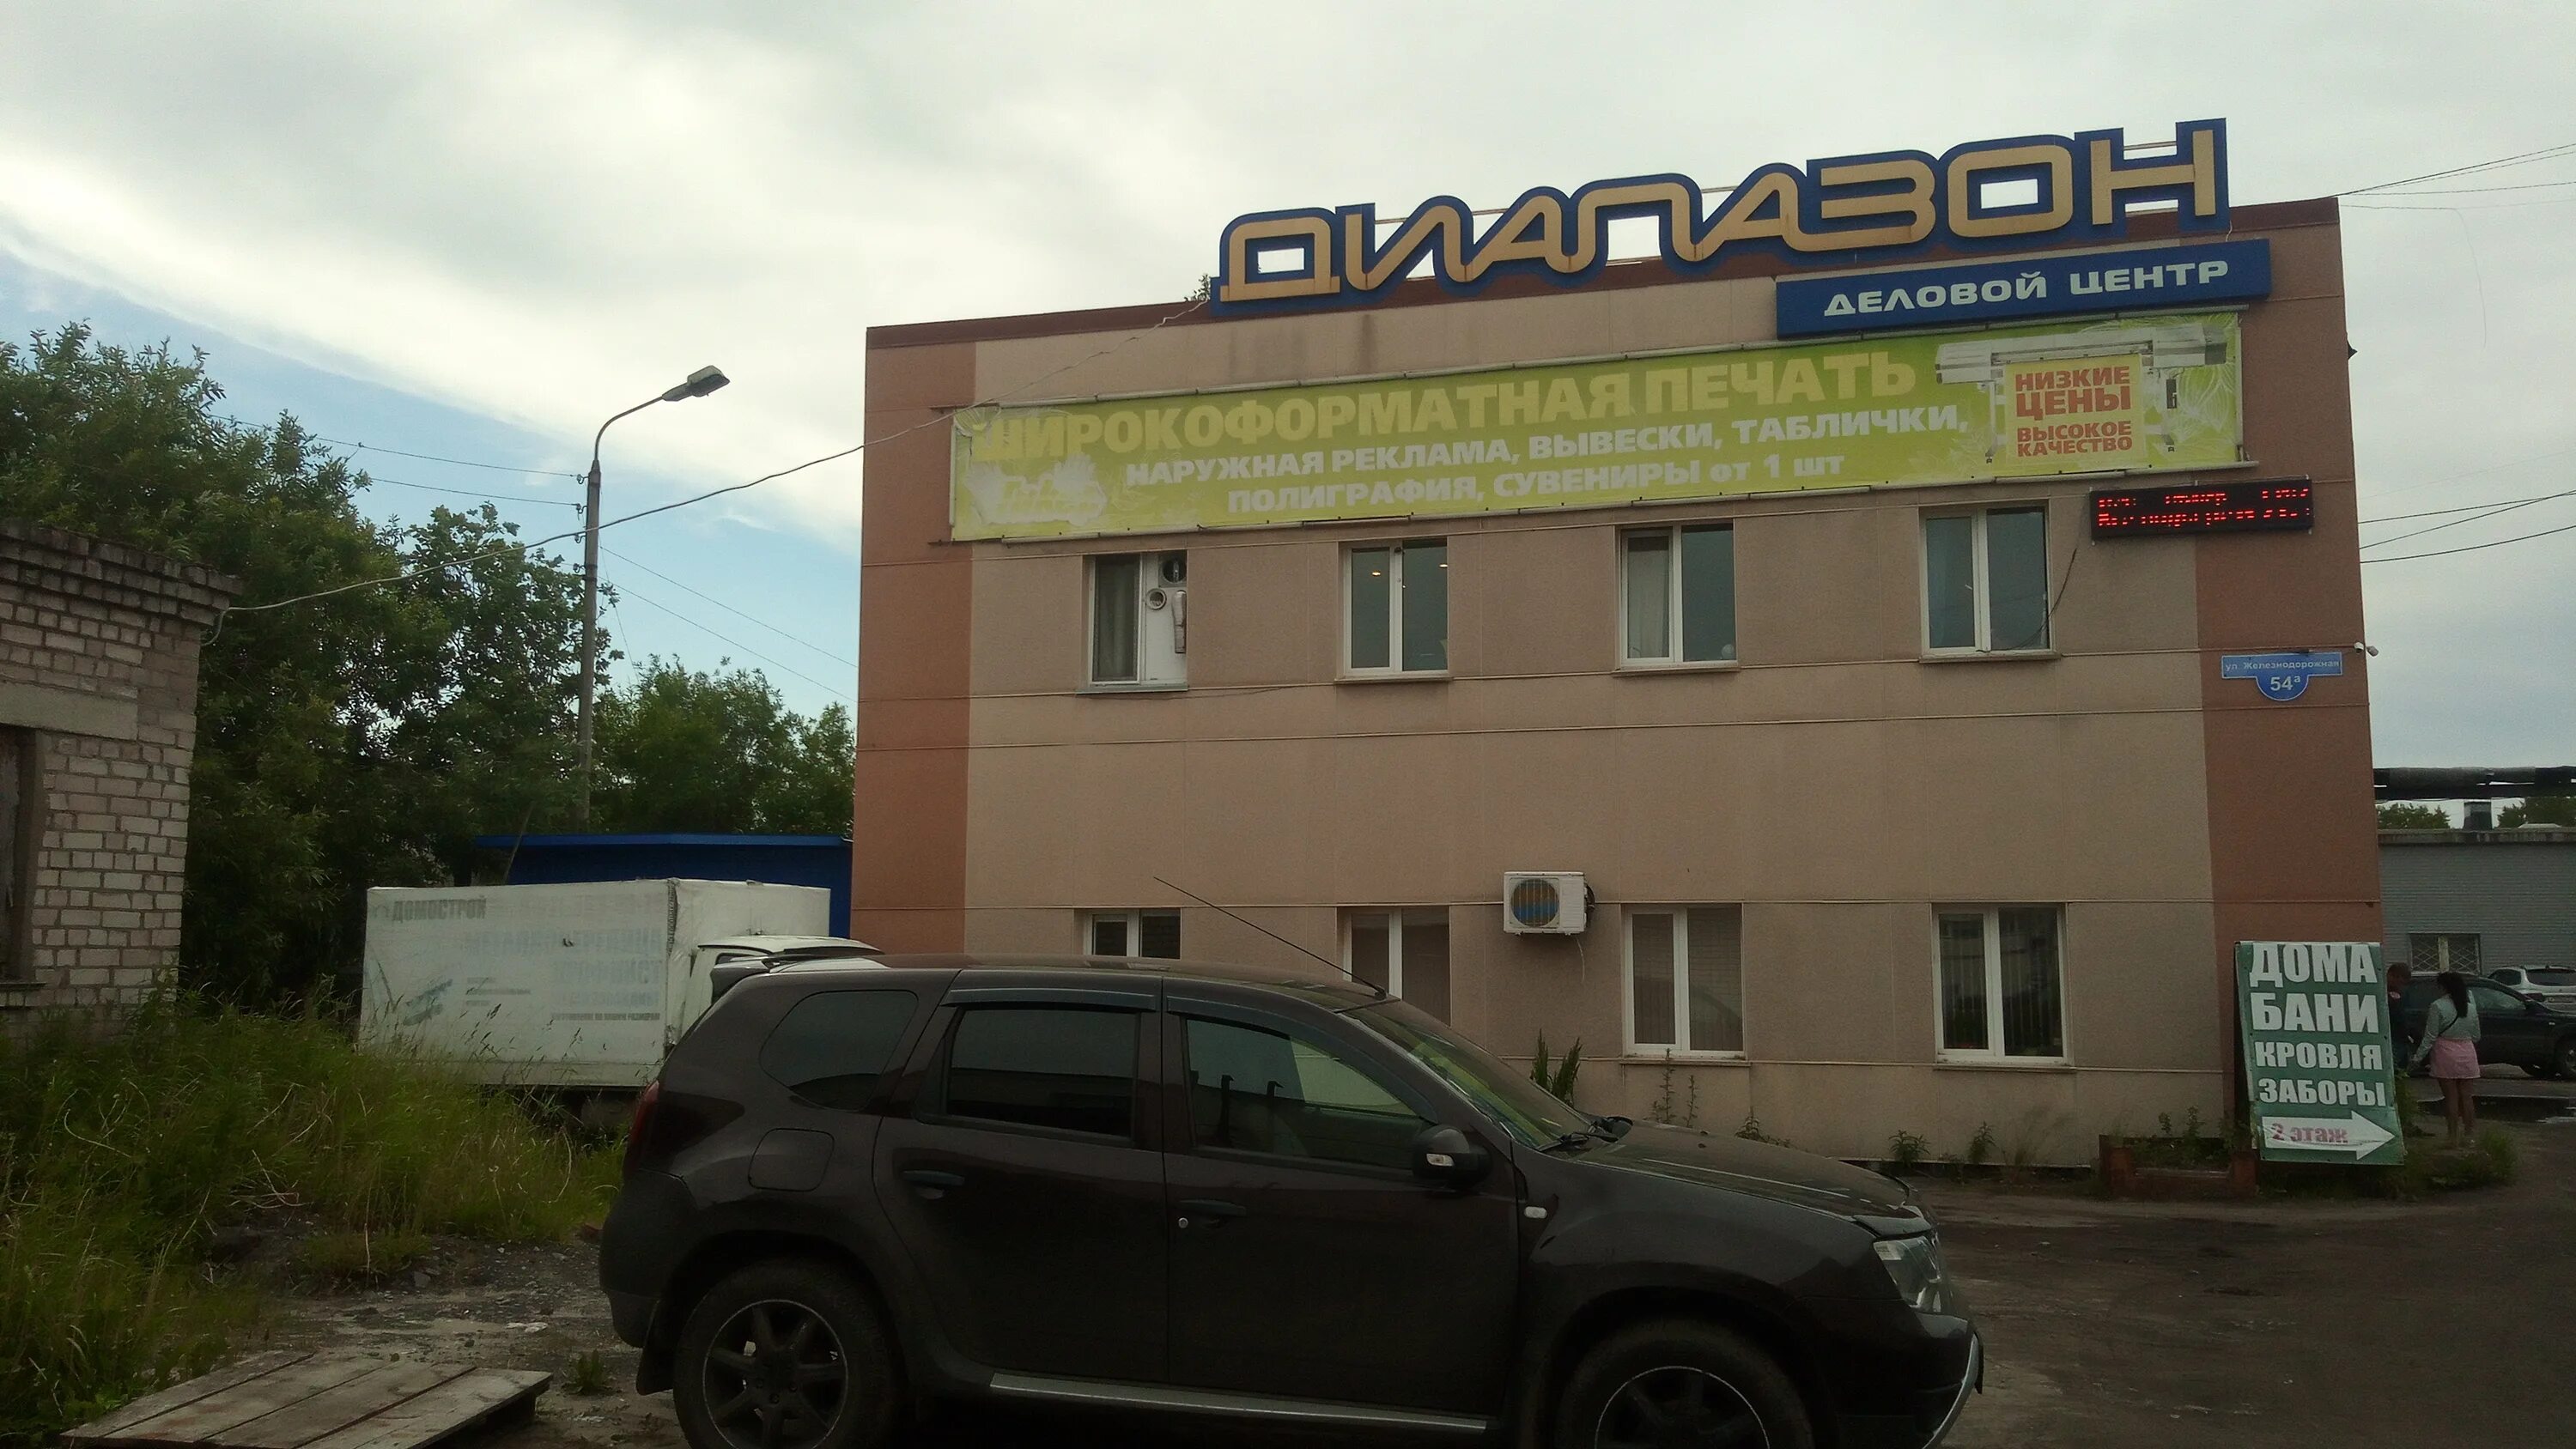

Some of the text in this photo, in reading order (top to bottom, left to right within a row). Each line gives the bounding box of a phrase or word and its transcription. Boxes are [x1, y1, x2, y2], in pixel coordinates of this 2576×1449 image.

[1215, 124, 2222, 307] ДИАПАЗОН
[1824, 260, 2229, 317] ДЕЛОВОЙ ЦЕНТР
[2015, 366, 2130, 391] НИЗКИЕ
[971, 351, 1917, 461] ШИРОКОФОРМАТНАЯ ПЕЧАТЬ
[2016, 385, 2131, 421] ЦЕНЫ
[1127, 404, 1969, 487] НАРУЖНАЯ РЕКЛАМА, ВЫВЕСКИ, ТАБЛИЧКИ,
[2017, 421, 2132, 442] ВЫСОКОЕ
[2018, 436, 2133, 458] КАЧЕСТВО
[1228, 476, 1485, 512] ПОЛИГРАФИЯ,
[1493, 459, 1701, 497] СУВЕНИРЫ
[1710, 462, 1751, 482] от
[1764, 454, 1780, 478] 1
[2243, 660, 2340, 670] Железнодорожная
[2250, 943, 2378, 987] ДОМА
[2251, 992, 2379, 1034] БАНИ
[2255, 1042, 2383, 1070] КРОВЛЯ
[2259, 1078, 2386, 1106] ЗАБОРЫ
[2271, 1123, 2348, 1143] 2 этаж
